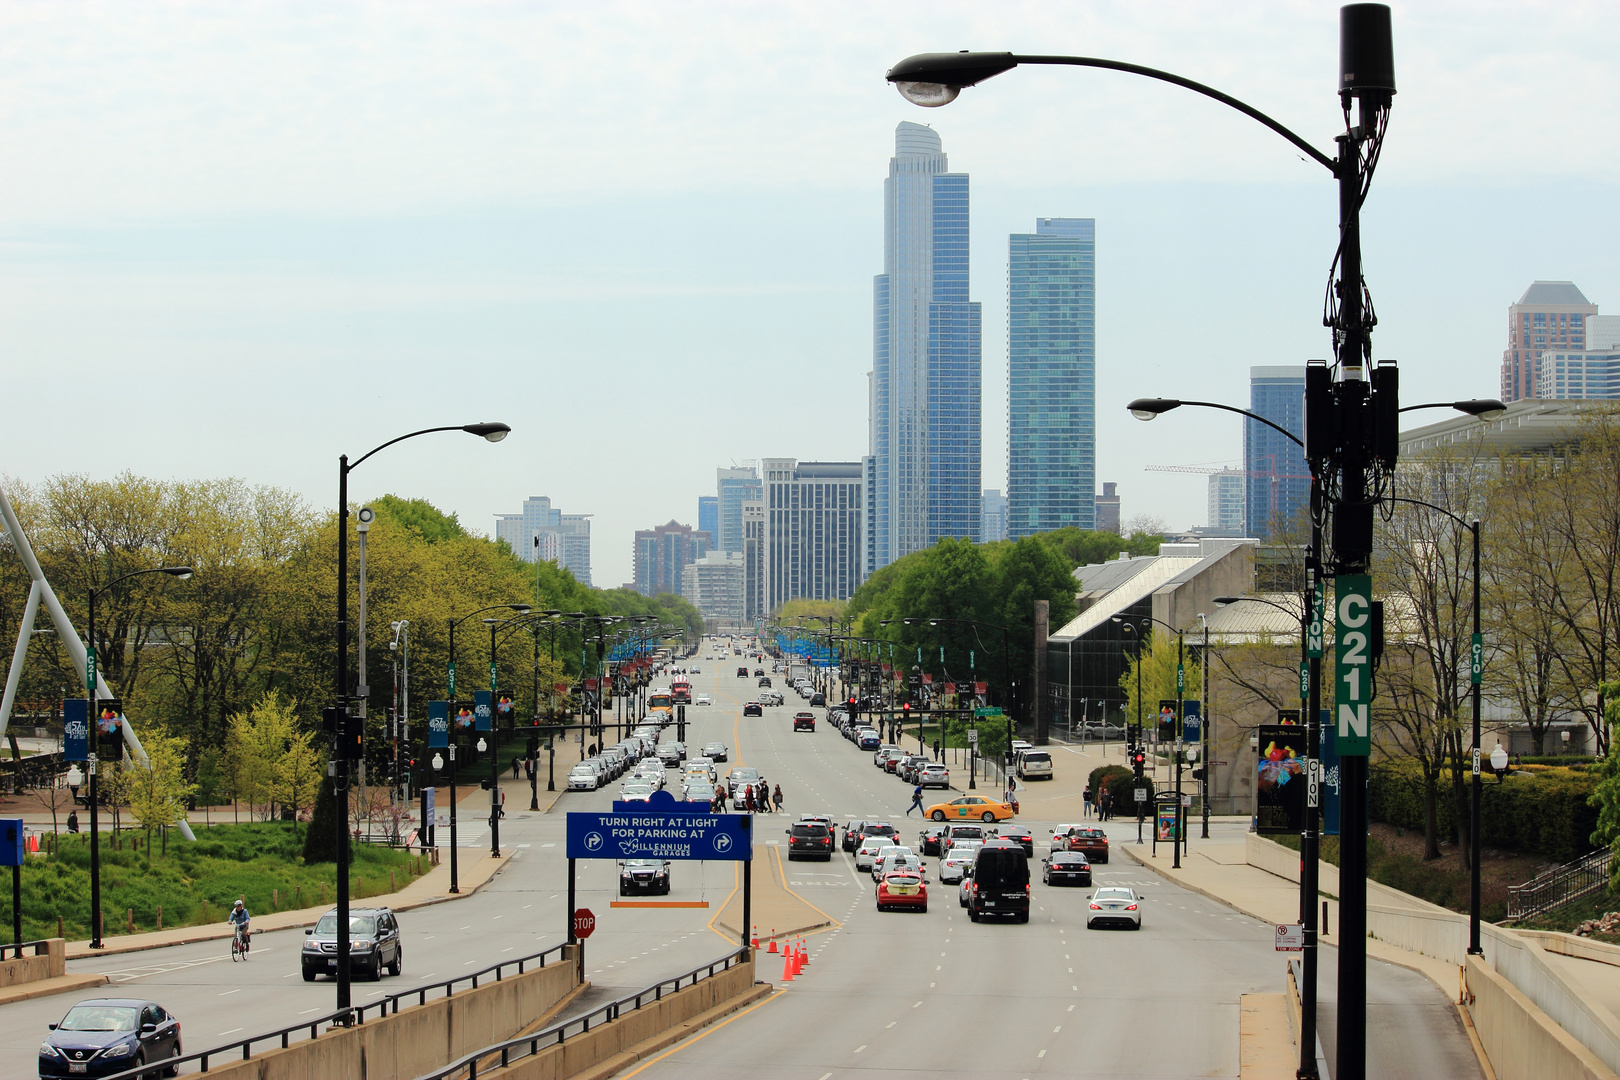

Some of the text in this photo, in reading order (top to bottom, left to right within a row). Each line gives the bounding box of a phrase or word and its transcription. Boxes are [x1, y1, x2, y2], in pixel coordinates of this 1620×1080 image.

[86, 656, 94, 682] C21
[1338, 594, 1368, 737] C21N
[1472, 644, 1481, 674] C10
[1309, 761, 1318, 805] C10N
[599, 818, 718, 827] TURN RIGHT AT LIGHT
[612, 829, 705, 838] FOR PARKING AT
[574, 918, 594, 930] STOP
